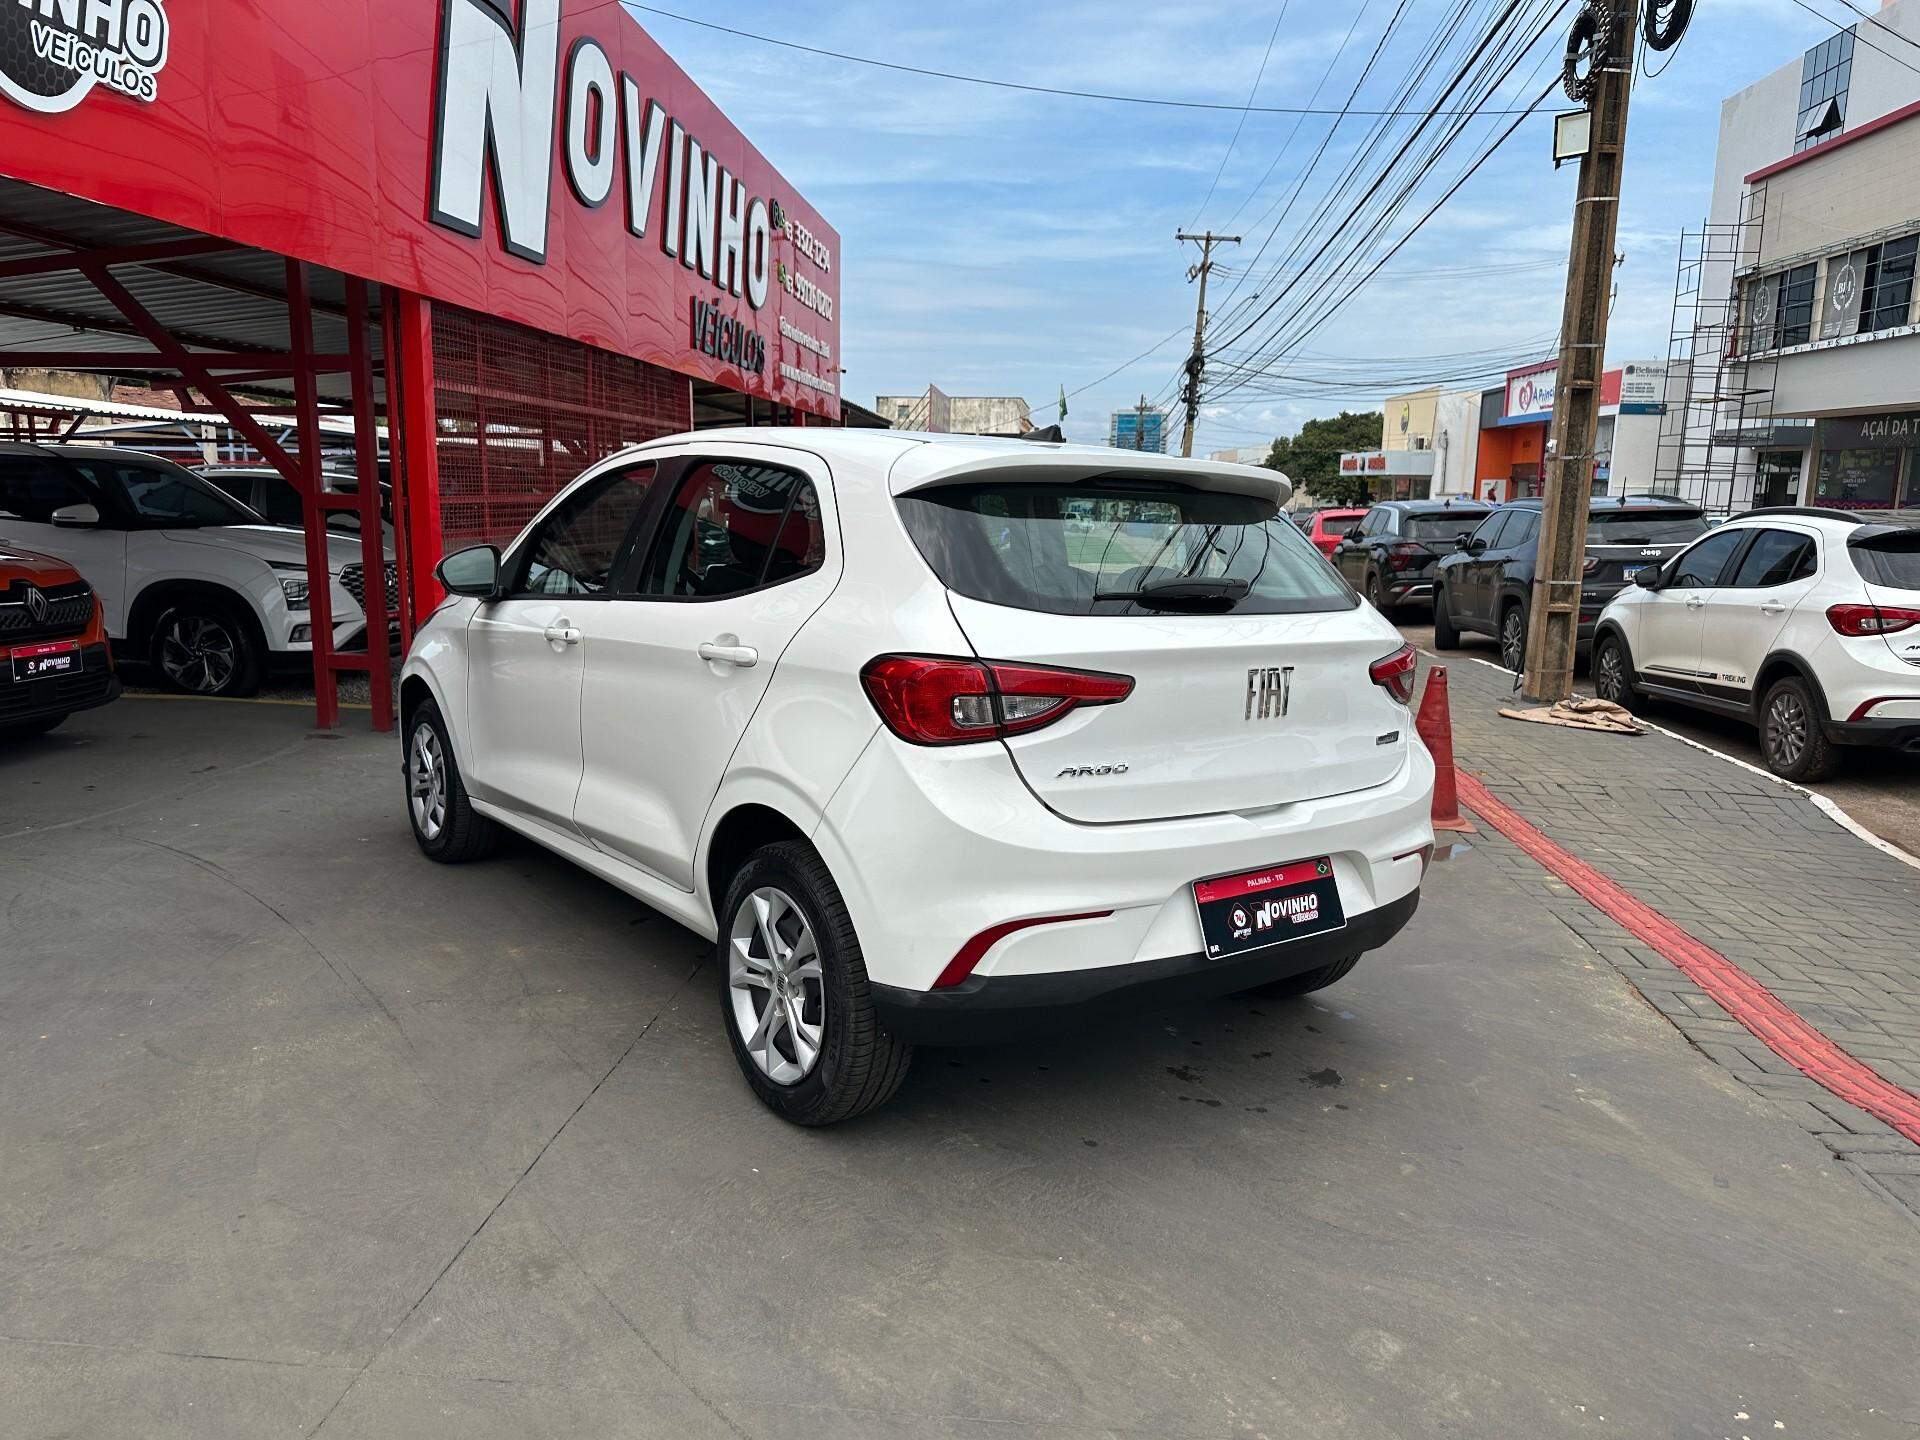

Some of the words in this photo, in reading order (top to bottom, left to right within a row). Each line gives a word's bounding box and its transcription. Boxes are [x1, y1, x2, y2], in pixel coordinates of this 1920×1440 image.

[32, 22, 155, 99] VEÍCULOS
[430, 0, 771, 310] NOVINHO
[692, 296, 766, 374] VEÍCULOS
[1861, 415, 1889, 440] AÇAÍ
[1892, 418, 1908, 434] DA
[39, 656, 71, 671] NOVINHO
[1245, 666, 1294, 720] FIAT
[1054, 762, 1129, 778] ARGO
[1247, 876, 1272, 888] PALMAS
[1256, 893, 1318, 929] NOVINHO
[1210, 944, 1220, 953] BR
